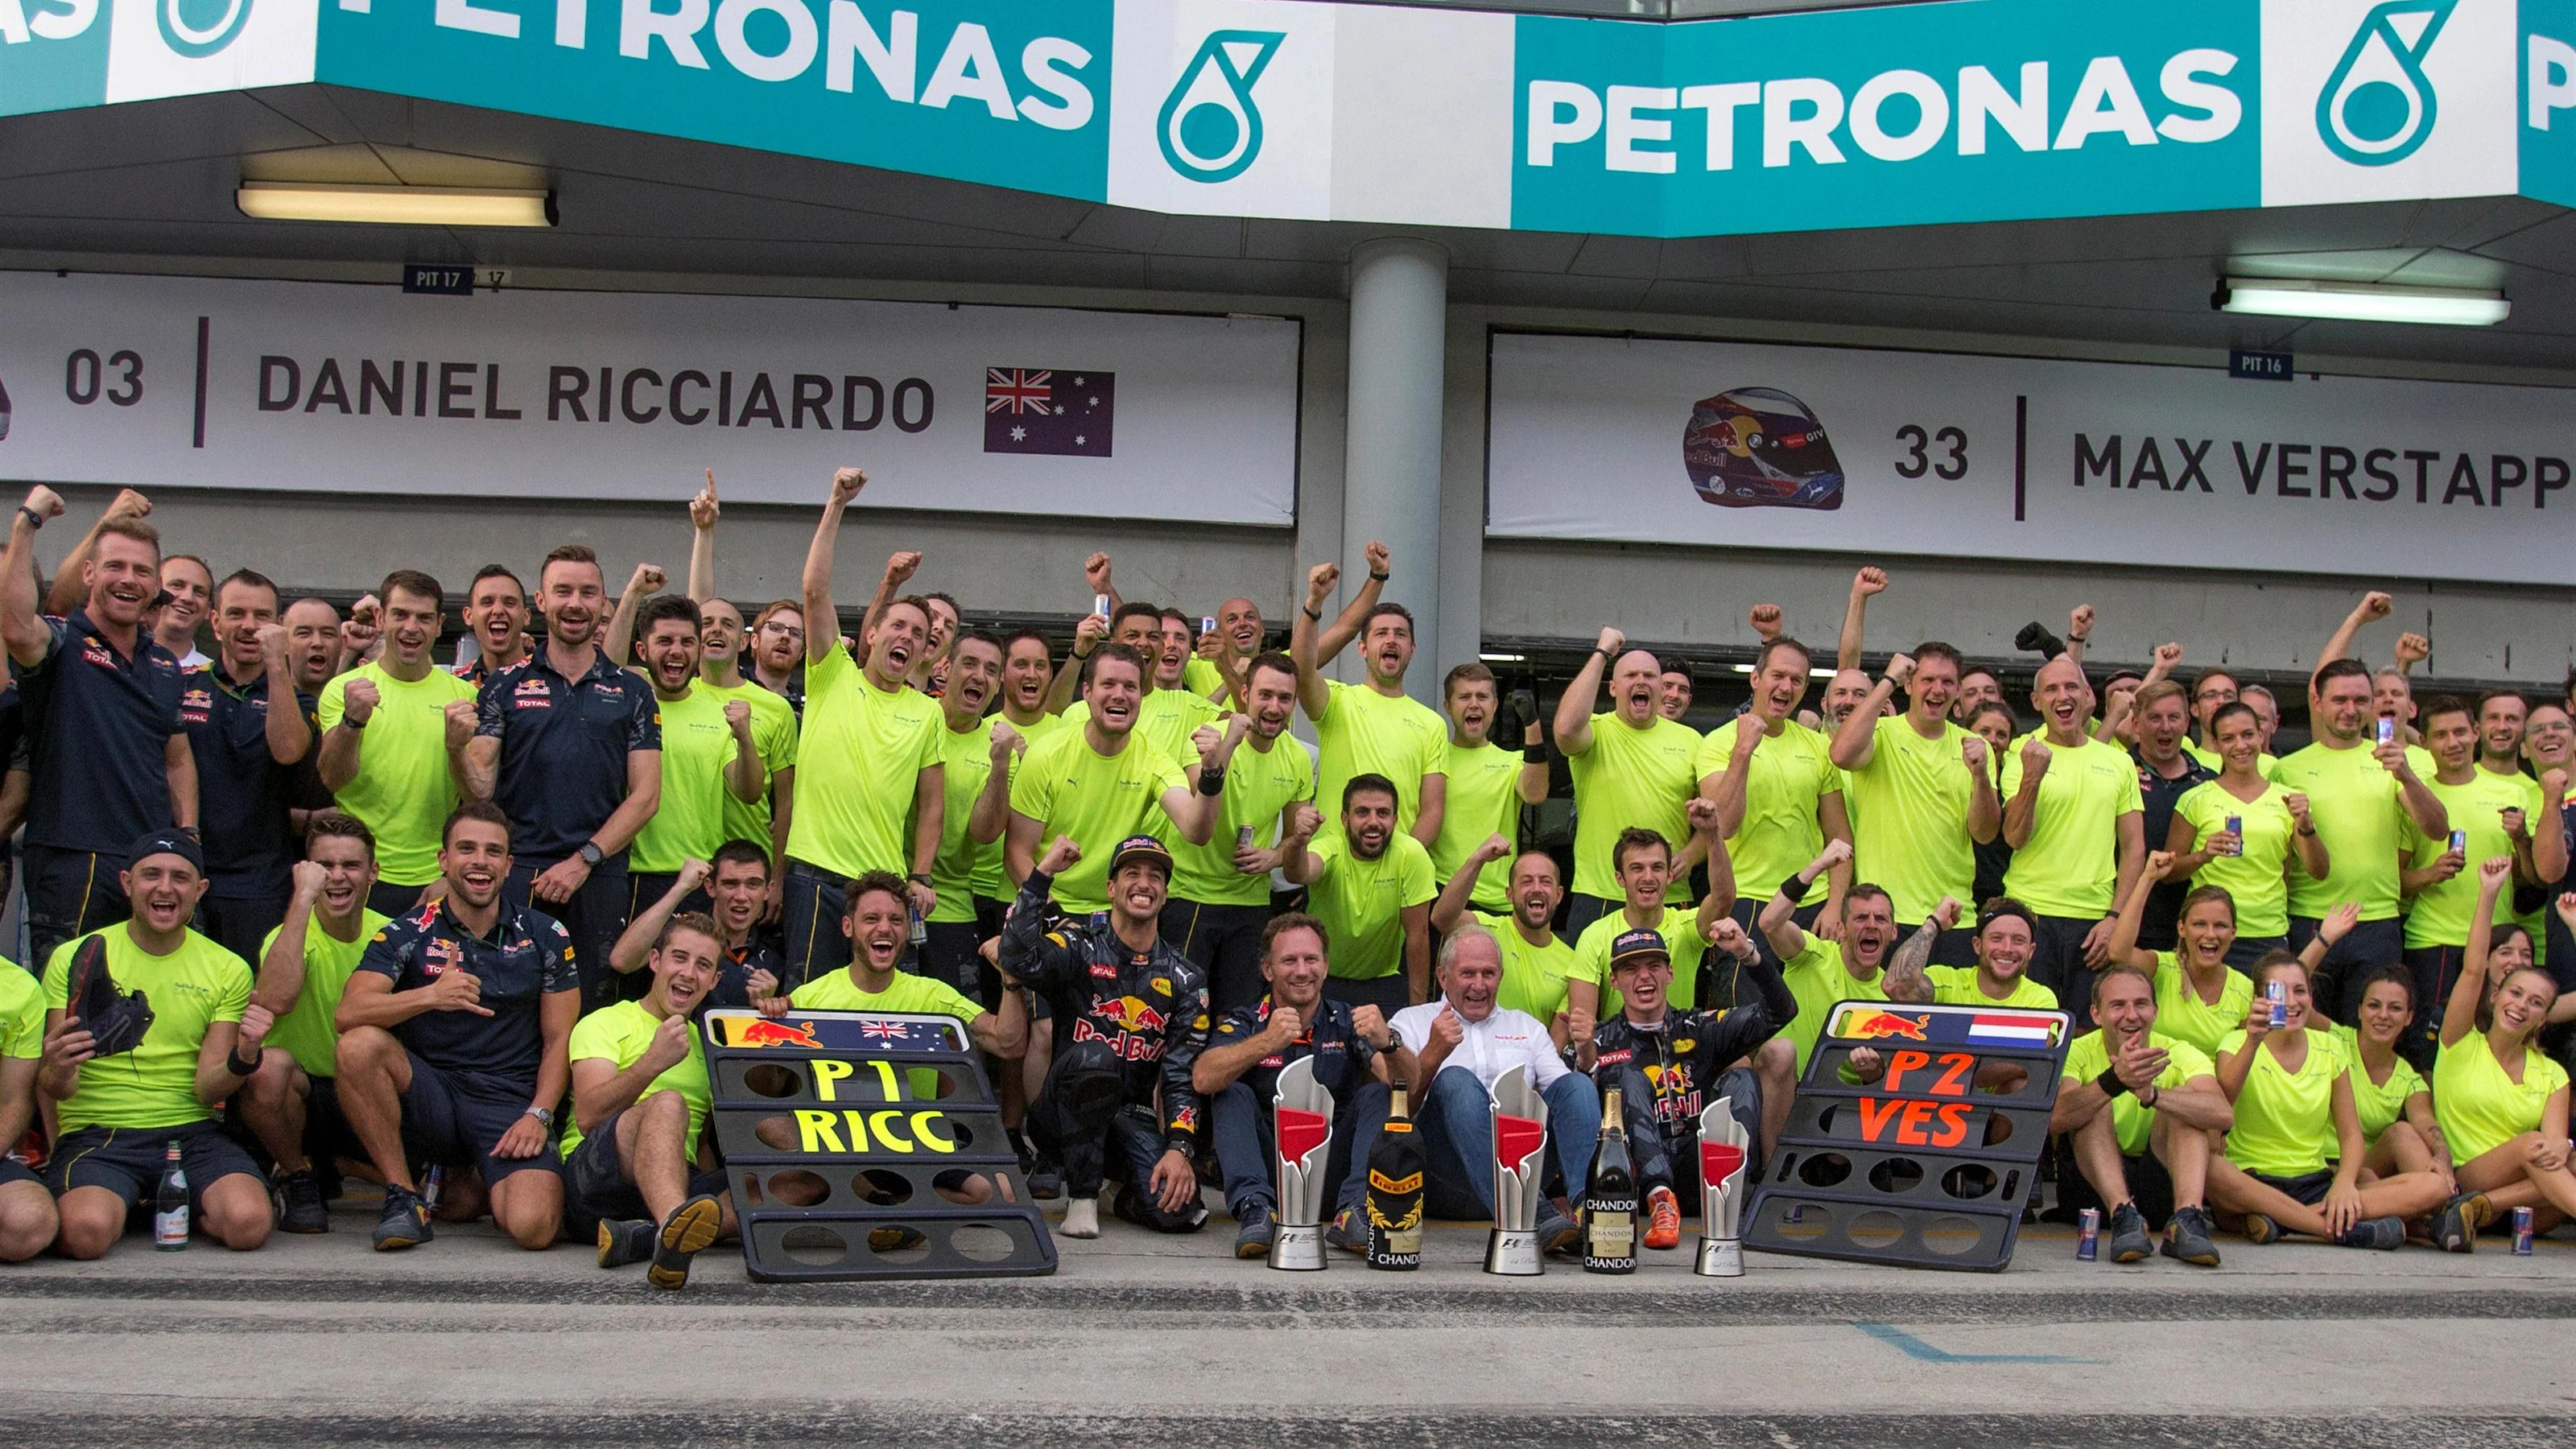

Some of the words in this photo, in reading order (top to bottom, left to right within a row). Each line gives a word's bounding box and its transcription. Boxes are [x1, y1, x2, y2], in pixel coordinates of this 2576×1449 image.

[1528, 49, 2241, 173] PETRONAS
[416, 270, 440, 287] PIT
[444, 272, 461, 287] 17
[489, 270, 506, 283] 17
[67, 349, 143, 406] 03
[2242, 356, 2262, 371] PIT
[2267, 357, 2282, 374] 16
[259, 356, 522, 419] DANIEL
[548, 366, 934, 432] RICCIARDO
[1895, 424, 1967, 480] 33
[2074, 433, 2213, 494] MAX
[2232, 441, 2570, 509] VERSTAPP
[1599, 1053, 1631, 1063] TOTAL
[793, 1109, 956, 1153] RICC
[1860, 1097, 1972, 1147] VES
[1587, 1199, 1638, 1211] CHANDON
